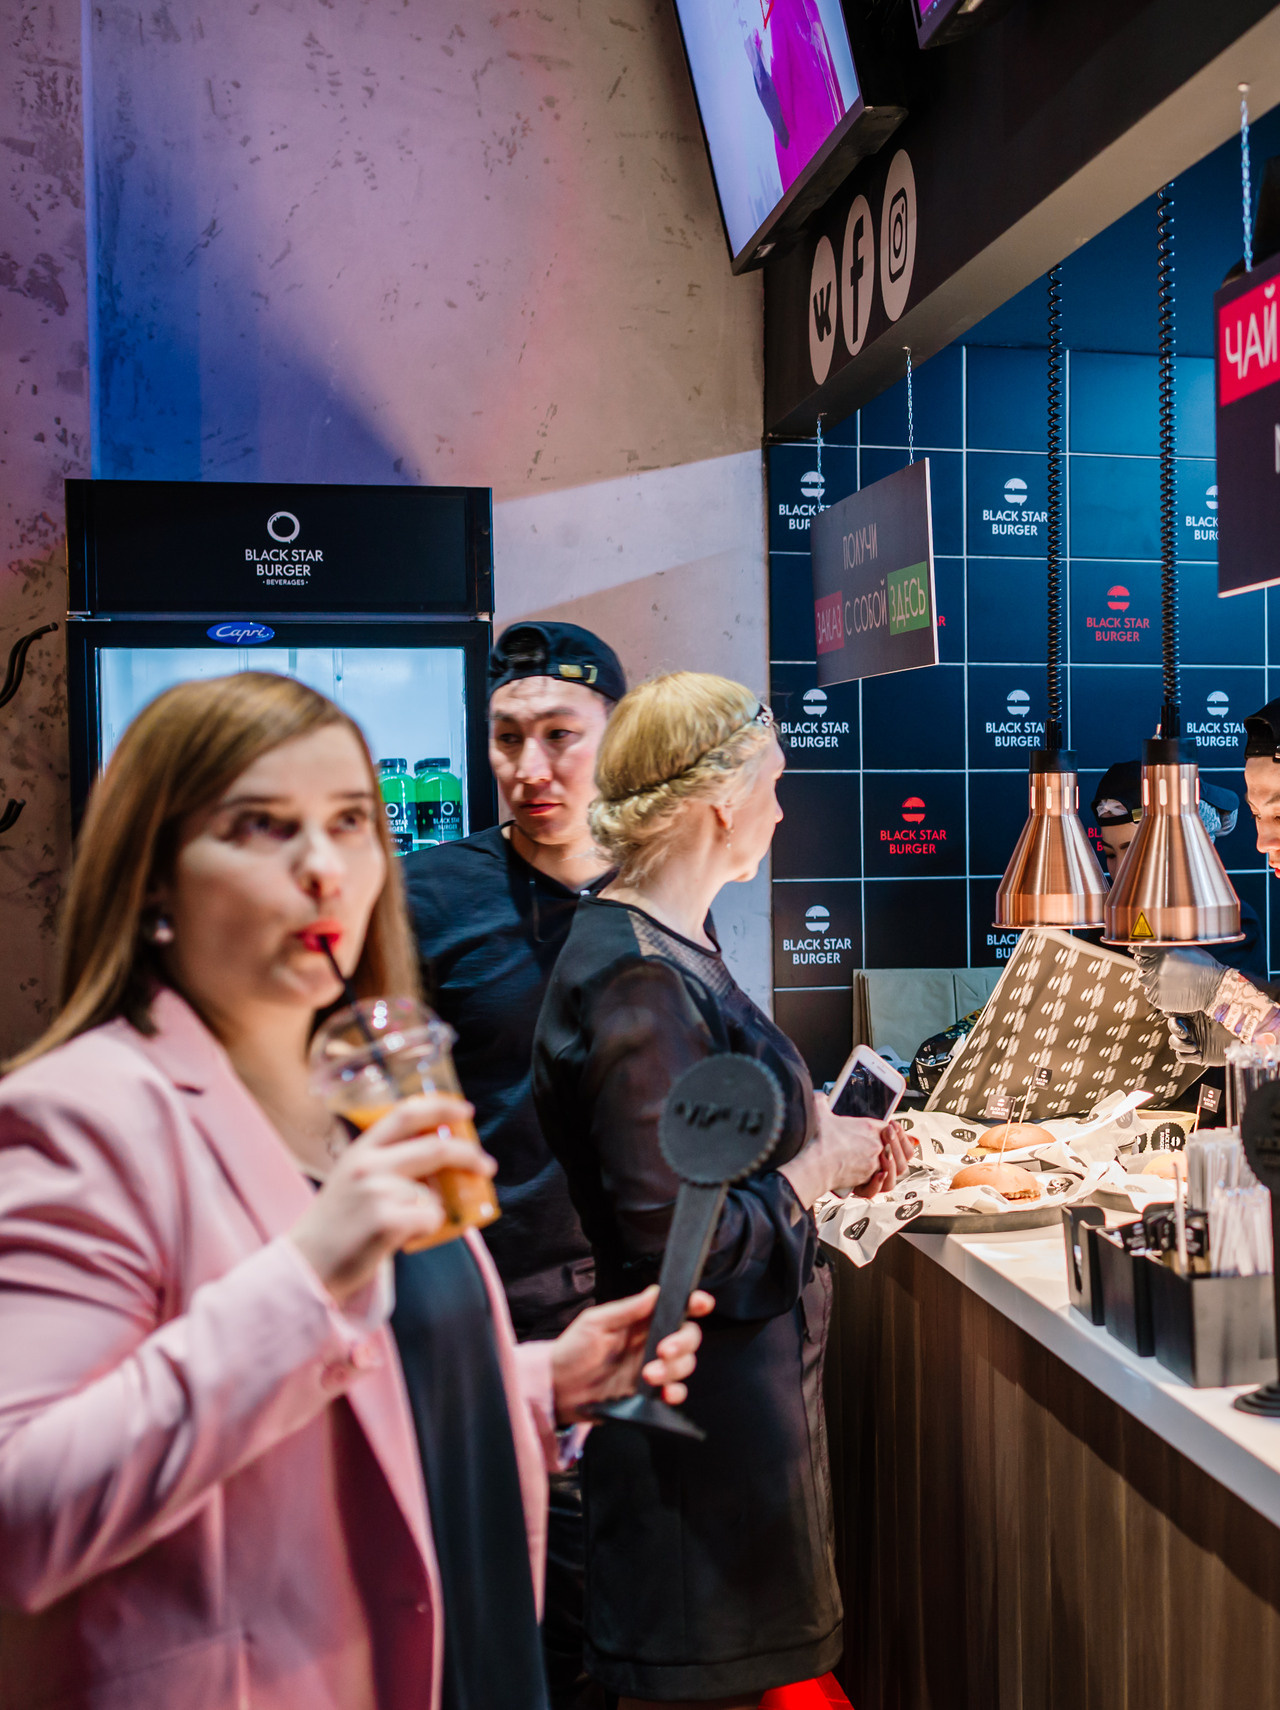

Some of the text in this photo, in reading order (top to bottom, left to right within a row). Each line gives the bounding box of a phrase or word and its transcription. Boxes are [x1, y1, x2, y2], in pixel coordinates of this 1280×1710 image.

[1224, 283, 1278, 379] ЧАЙ
[778, 504, 817, 516] BLACK
[982, 509, 1049, 523] BLACK STAR
[789, 518, 811, 530] BUR
[1185, 515, 1219, 527] BLACK
[992, 523, 1039, 536] BURGER
[1194, 529, 1219, 541] BUR
[843, 522, 878, 570] ПОЛУЧИ
[245, 549, 324, 562] BLACK STAR
[256, 564, 311, 577] BURGER
[816, 577, 926, 645] ЗАКАЗ С СОБОЙ ЗДЕСЬ
[1086, 616, 1150, 629] BLACK STAR
[215, 625, 270, 643] Capri
[1095, 630, 1140, 642] BURGER
[781, 722, 849, 734] BLACK STAR
[985, 722, 1046, 733] BLACK STA
[1187, 722, 1221, 733] BLACK
[790, 735, 838, 748] BURGER
[995, 735, 1041, 747] BURGER
[1195, 735, 1239, 747] BURGER
[880, 830, 946, 841] BLACK STAR
[889, 843, 936, 855] BURGER
[783, 938, 852, 951] BLACK STAR
[792, 951, 841, 965] BURGER
